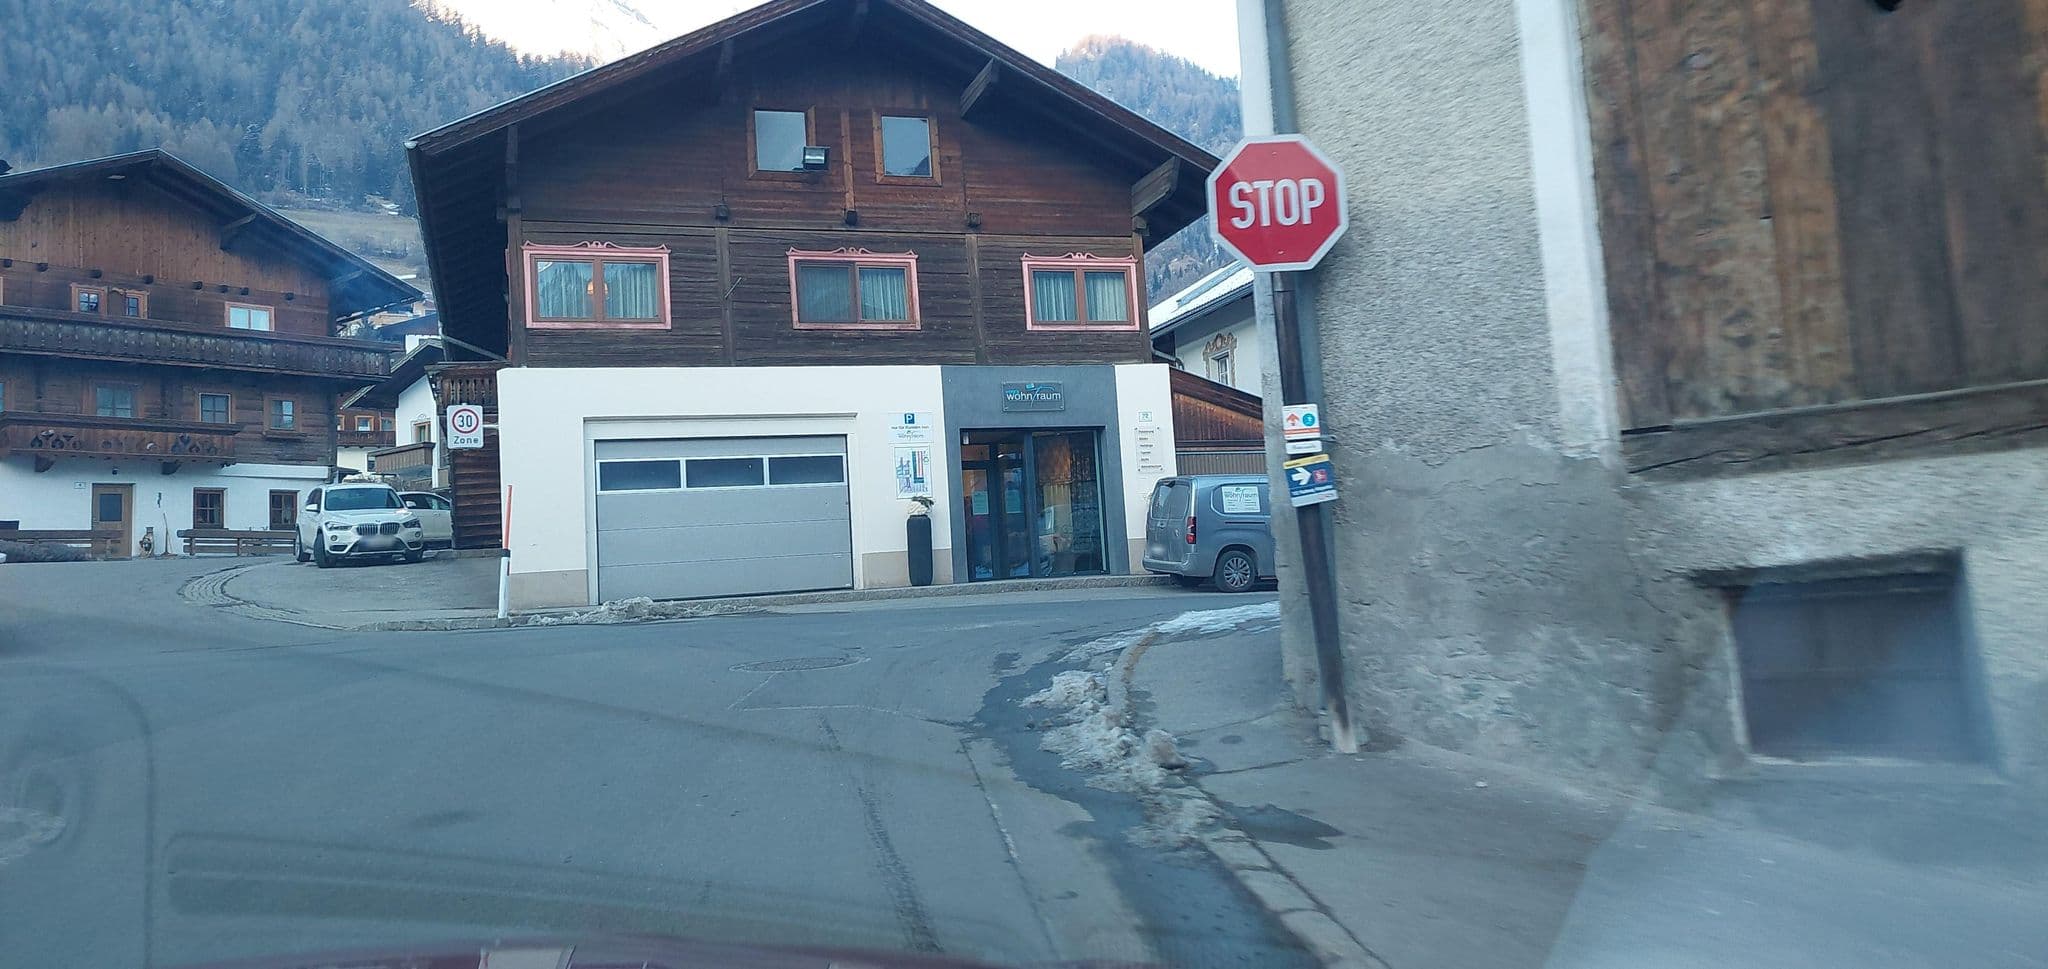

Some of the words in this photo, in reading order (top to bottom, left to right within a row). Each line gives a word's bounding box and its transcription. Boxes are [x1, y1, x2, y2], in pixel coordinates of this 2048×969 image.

[1229, 178, 1325, 229] STOP
[457, 414, 473, 428] 30
[906, 414, 914, 424] P
[453, 435, 479, 445] Zone
